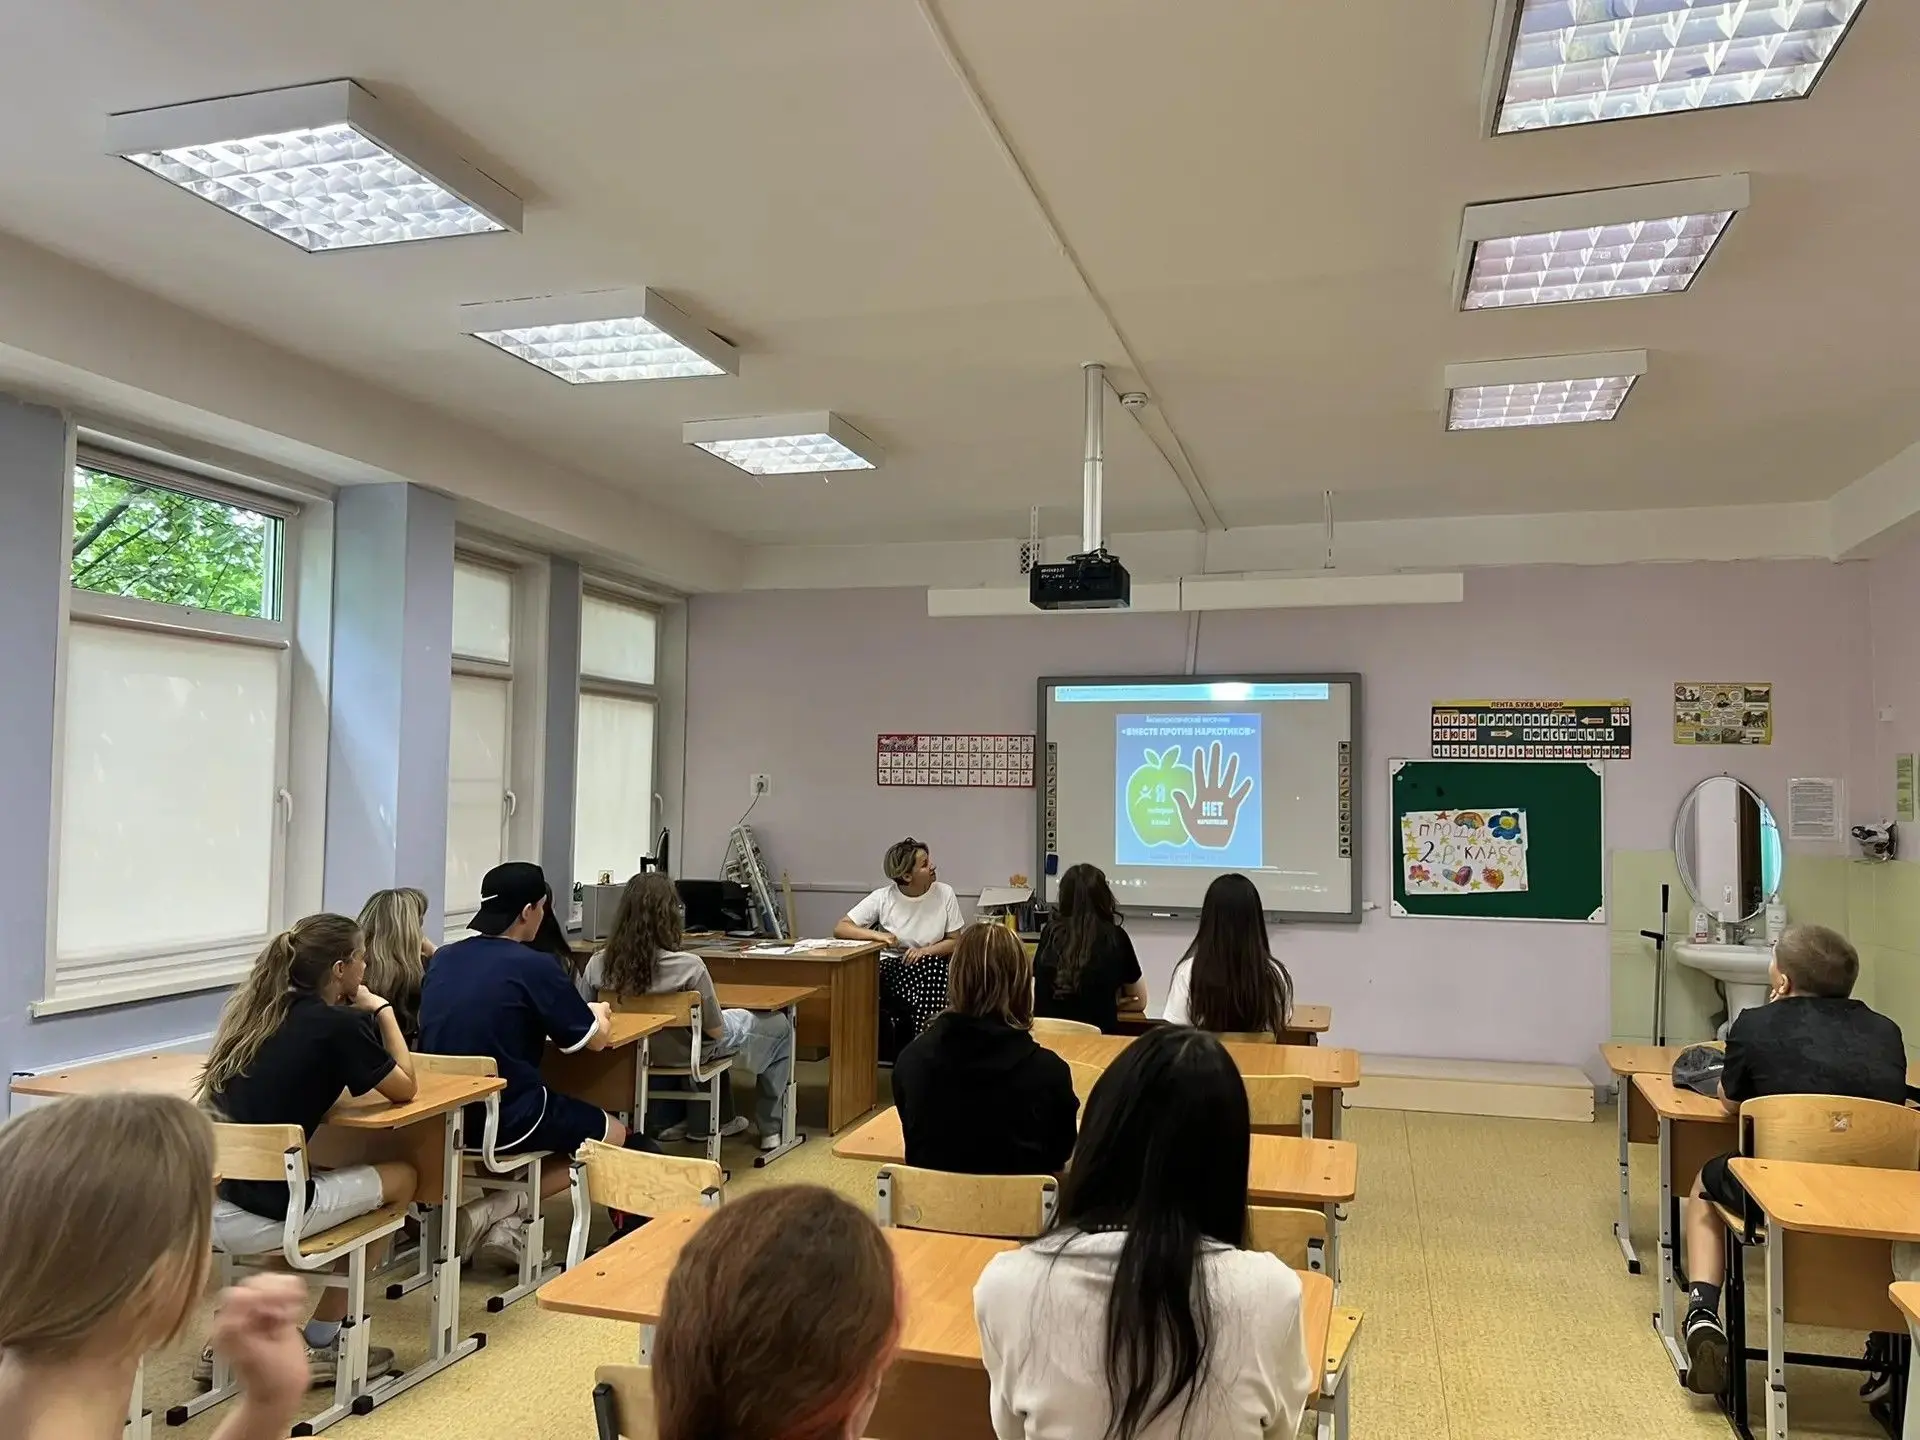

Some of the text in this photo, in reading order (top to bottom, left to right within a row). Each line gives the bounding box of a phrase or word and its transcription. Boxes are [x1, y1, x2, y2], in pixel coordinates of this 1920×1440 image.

[1160, 727, 1193, 736] ПРОТИВ
[1202, 801, 1224, 817] НЕТ
[1420, 840, 1435, 863] 2
